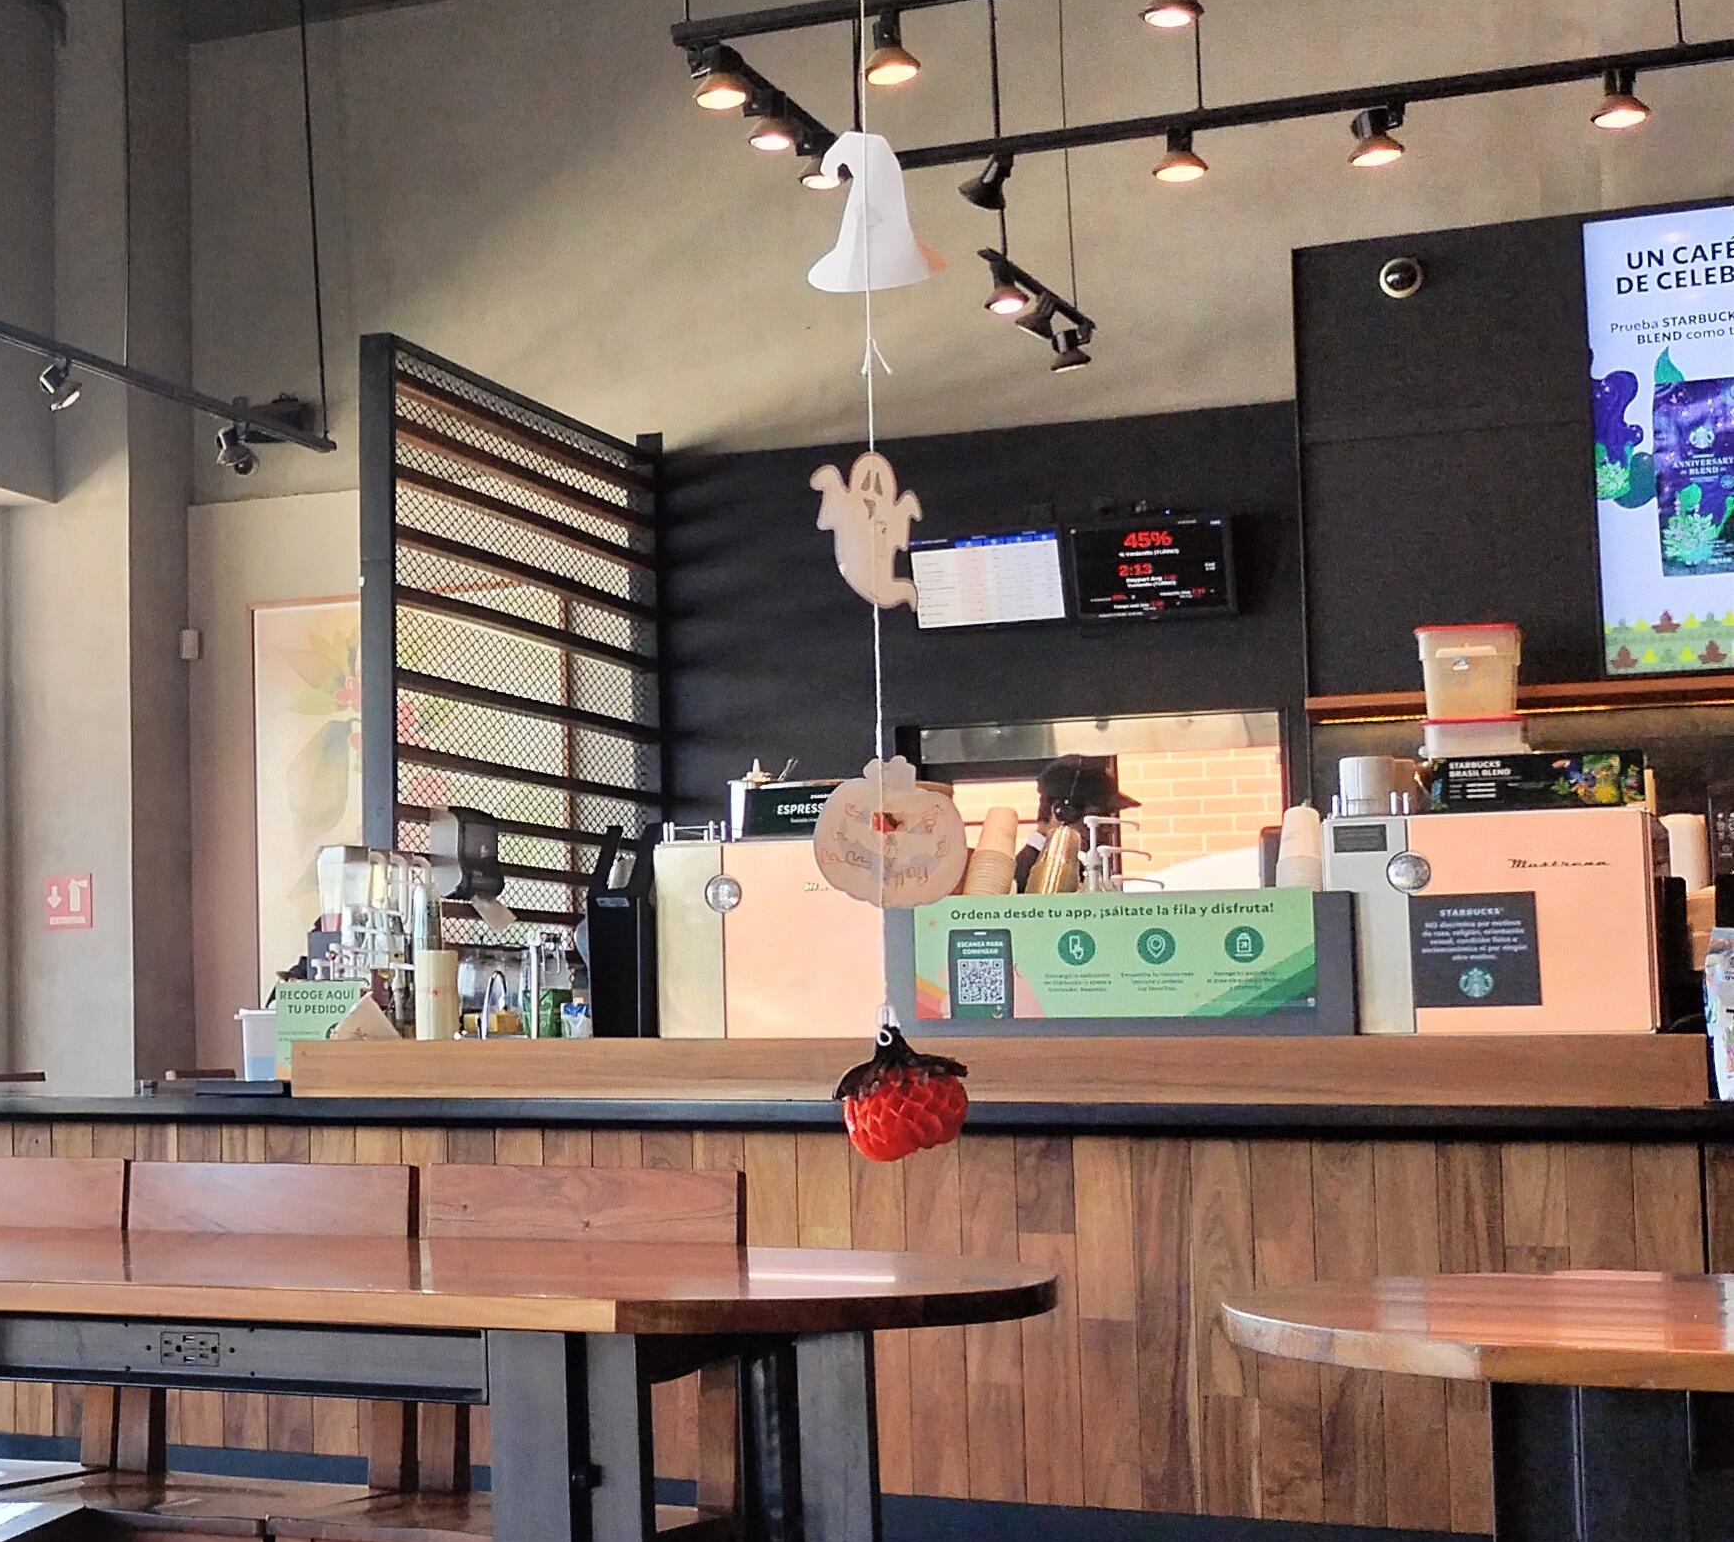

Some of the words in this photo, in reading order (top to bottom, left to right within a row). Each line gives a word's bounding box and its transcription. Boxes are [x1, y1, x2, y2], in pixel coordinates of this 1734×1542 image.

[1627, 249, 1664, 270] UN
[1617, 274, 1648, 295] DE
[1610, 320, 1658, 333] Prueba
[1637, 331, 1682, 344] BLEND
[1686, 328, 1725, 339] como
[1689, 466, 1719, 475] BLEND
[1122, 530, 1173, 548] 45%
[1448, 760, 1501, 770] STARBUCKS
[1448, 769, 1480, 778] BRASIL
[1481, 768, 1512, 776] BLEND
[950, 909, 1001, 920] Ordena
[1004, 907, 1045, 919] desde
[1048, 908, 1062, 918] tu
[1066, 908, 1097, 920] app,
[1157, 904, 1169, 916] la
[1173, 903, 1196, 915] fila
[1200, 905, 1208, 917] y
[1211, 902, 1274, 914] disfruta!
[279, 990, 323, 1000] RECOGE
[326, 988, 354, 999] AQUÍ
[287, 1005, 302, 1014] TU
[304, 1004, 346, 1014] PEDIDO
